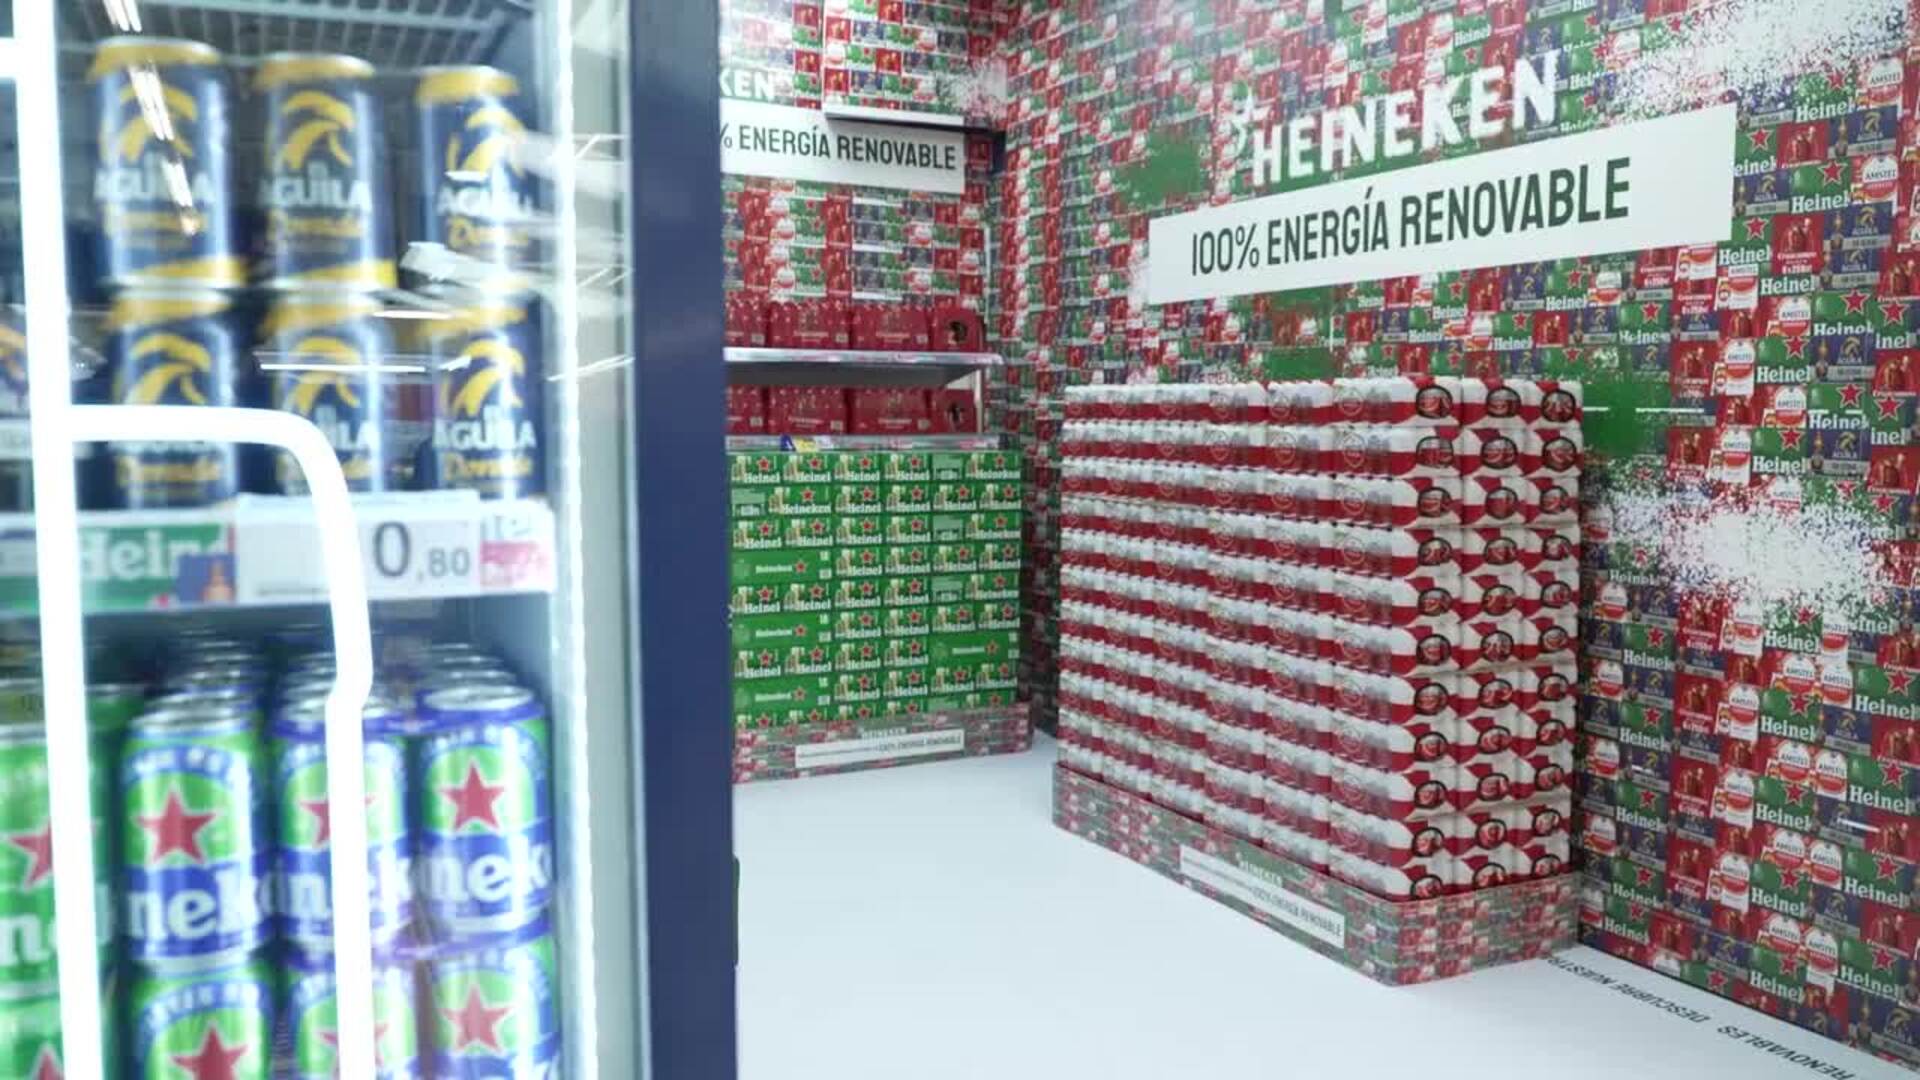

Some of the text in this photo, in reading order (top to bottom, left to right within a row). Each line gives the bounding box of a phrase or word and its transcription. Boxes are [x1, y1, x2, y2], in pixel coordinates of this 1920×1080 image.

[738, 126, 831, 159] ENERGÍA
[837, 136, 957, 170] RENOVABLE
[1250, 50, 1559, 188] HEINEKEN
[1192, 156, 1630, 276] 100% ENERGÍA RENOVABLE
